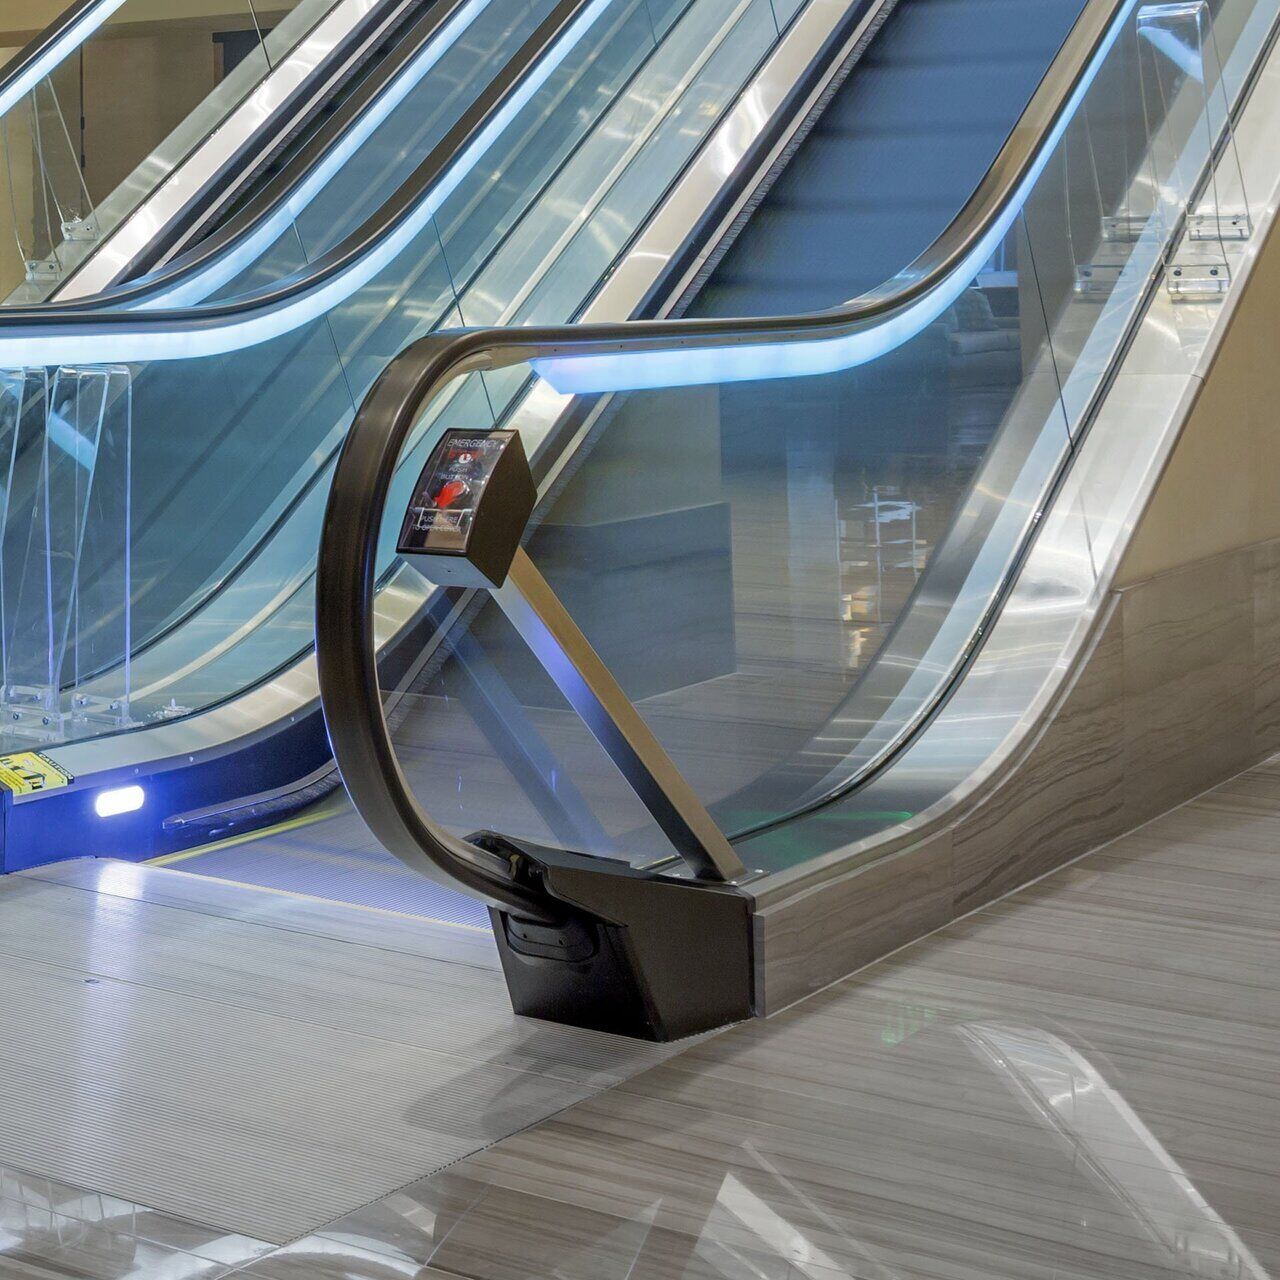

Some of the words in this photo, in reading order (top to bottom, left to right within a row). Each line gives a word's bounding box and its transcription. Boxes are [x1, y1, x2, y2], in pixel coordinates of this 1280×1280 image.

[447, 438, 498, 448] EMERGENCY
[448, 465, 468, 473] PUSH
[38, 753, 74, 780] CAUTION
